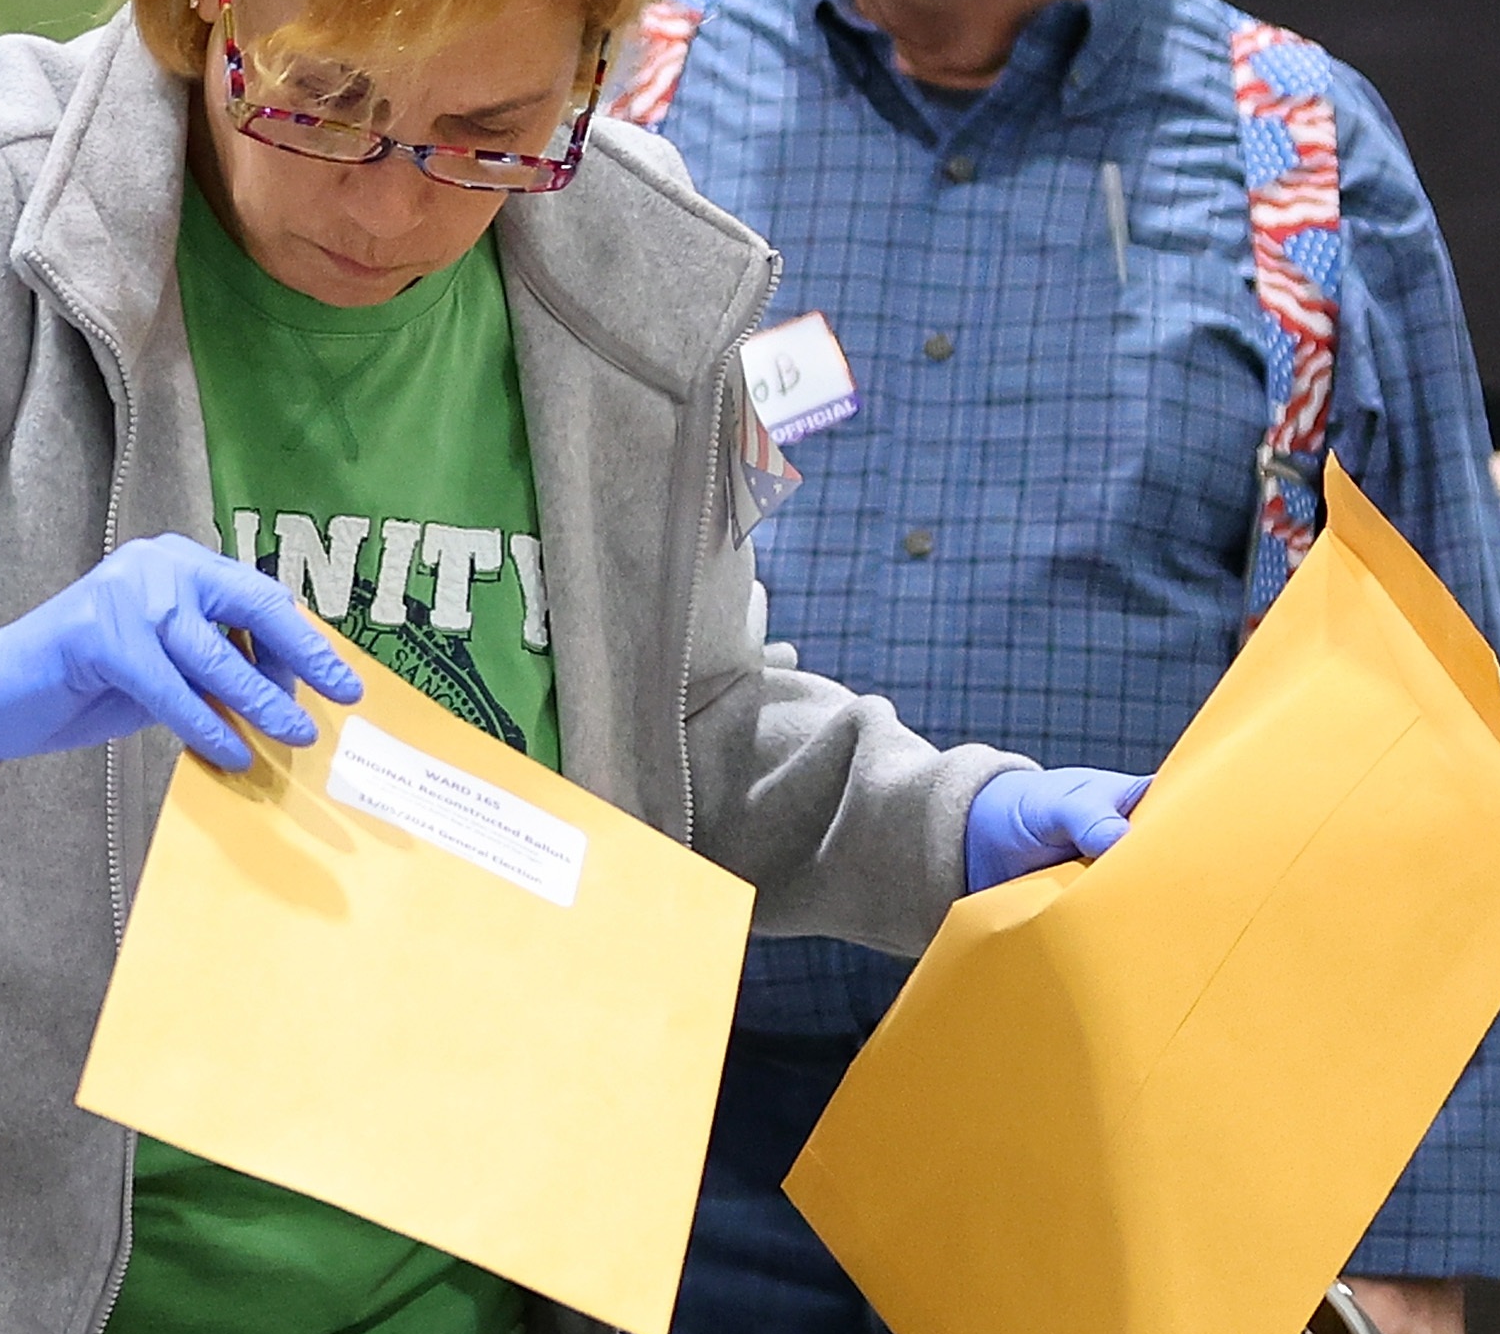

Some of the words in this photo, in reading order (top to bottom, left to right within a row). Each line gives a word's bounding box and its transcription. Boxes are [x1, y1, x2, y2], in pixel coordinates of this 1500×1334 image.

[344, 748, 413, 788] ORIGINAL
[418, 783, 521, 839] Reconstructed
[524, 833, 572, 864] Ballots
[425, 768, 471, 796] WARD
[477, 788, 501, 810] 165
